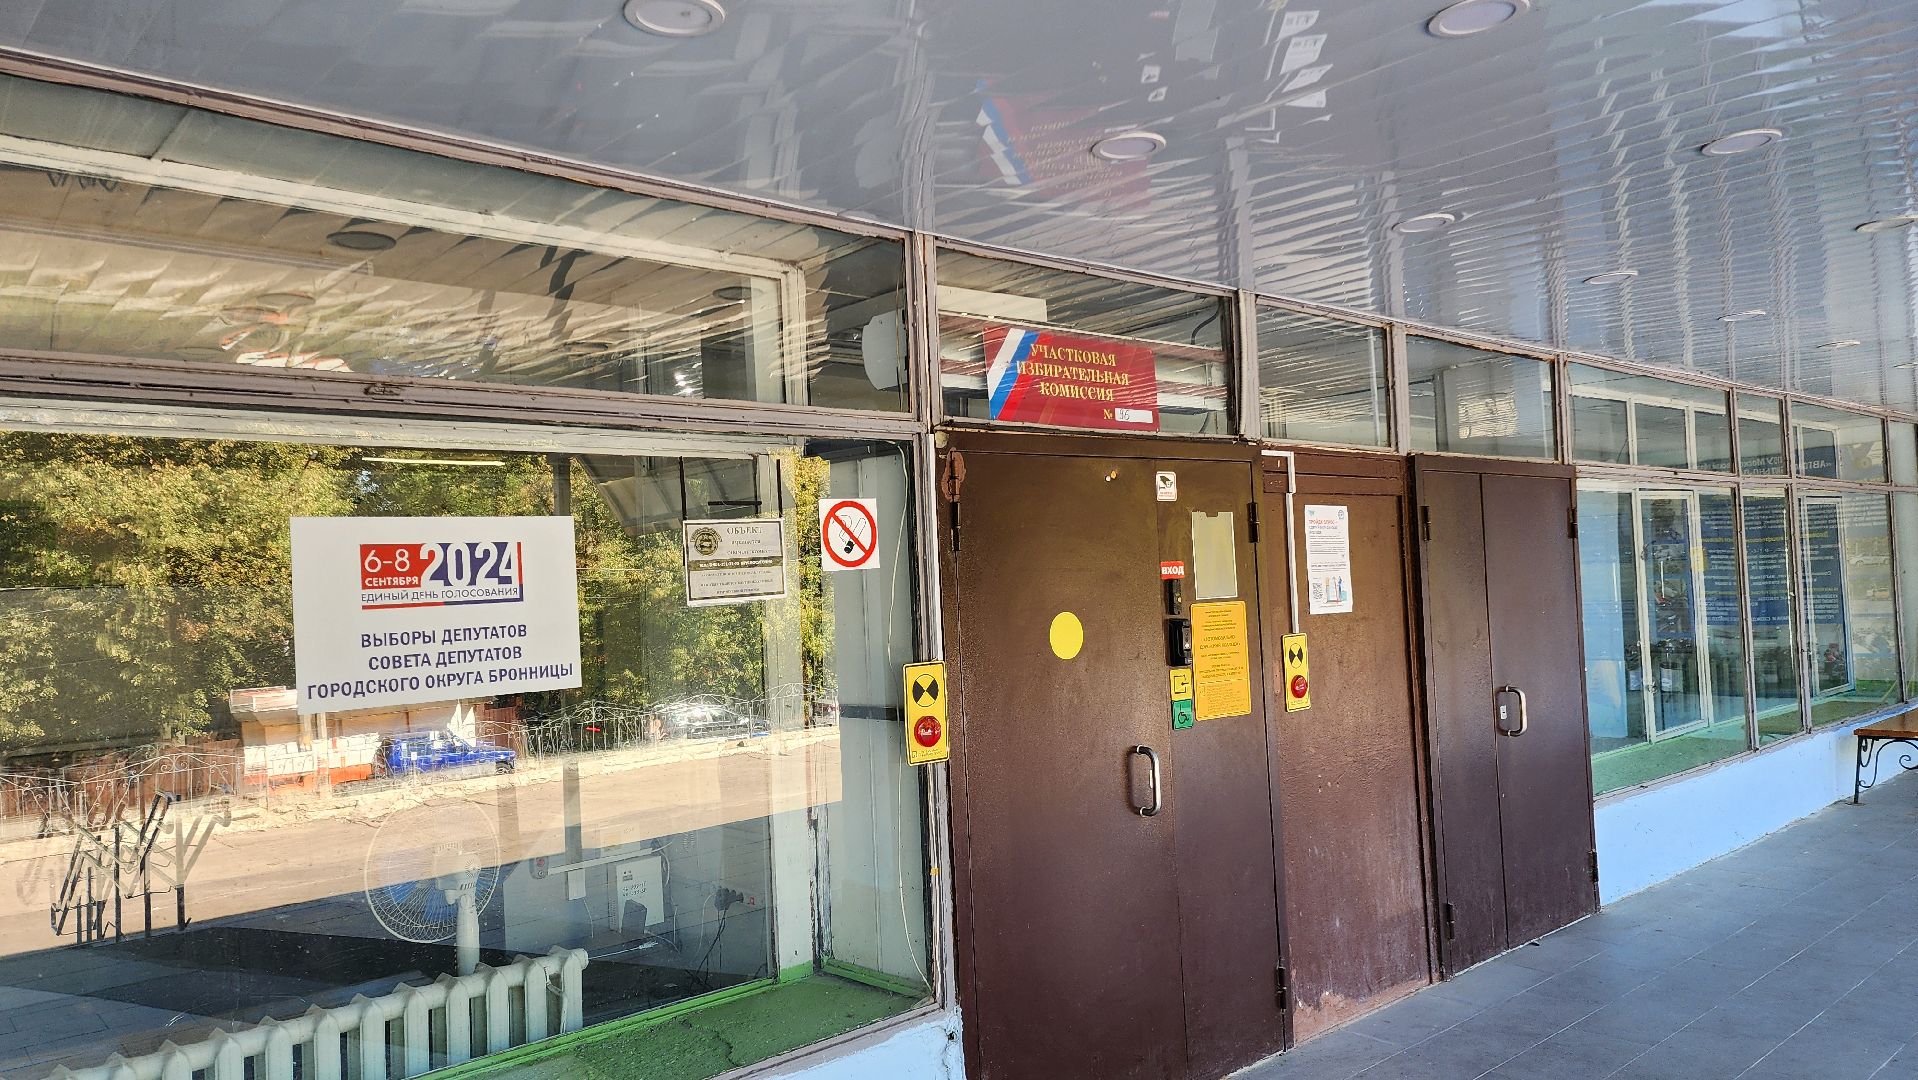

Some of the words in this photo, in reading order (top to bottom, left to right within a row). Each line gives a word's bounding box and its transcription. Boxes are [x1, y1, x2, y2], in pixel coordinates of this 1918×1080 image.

[1030, 344, 1117, 367] УЧАСТКОВАЯ
[1016, 360, 1129, 386] ИЗБИРАТЕЛЬНАЯ
[1039, 381, 1115, 402] КОМИССИЯ
[419, 542, 513, 587] 2024
[1161, 565, 1185, 576] ВХОД
[365, 576, 419, 587] СЕНТЯБРЯ
[361, 590, 410, 602] ЕДИНЫЙ
[411, 591, 439, 601] ДЕНЬ
[441, 588, 518, 599] ГОЛОСОВАНИЯ
[361, 629, 436, 648] ВЫБОРЫ
[441, 624, 527, 645] ДЕПУТАТОВ
[368, 653, 432, 670] СОВЕТА
[436, 646, 522, 668] ДЕПУТАТОВ
[307, 676, 420, 700] ГОРОДСКОГО
[425, 669, 484, 690] ОКРУГА
[488, 663, 573, 684] БРОННИЦЫ
